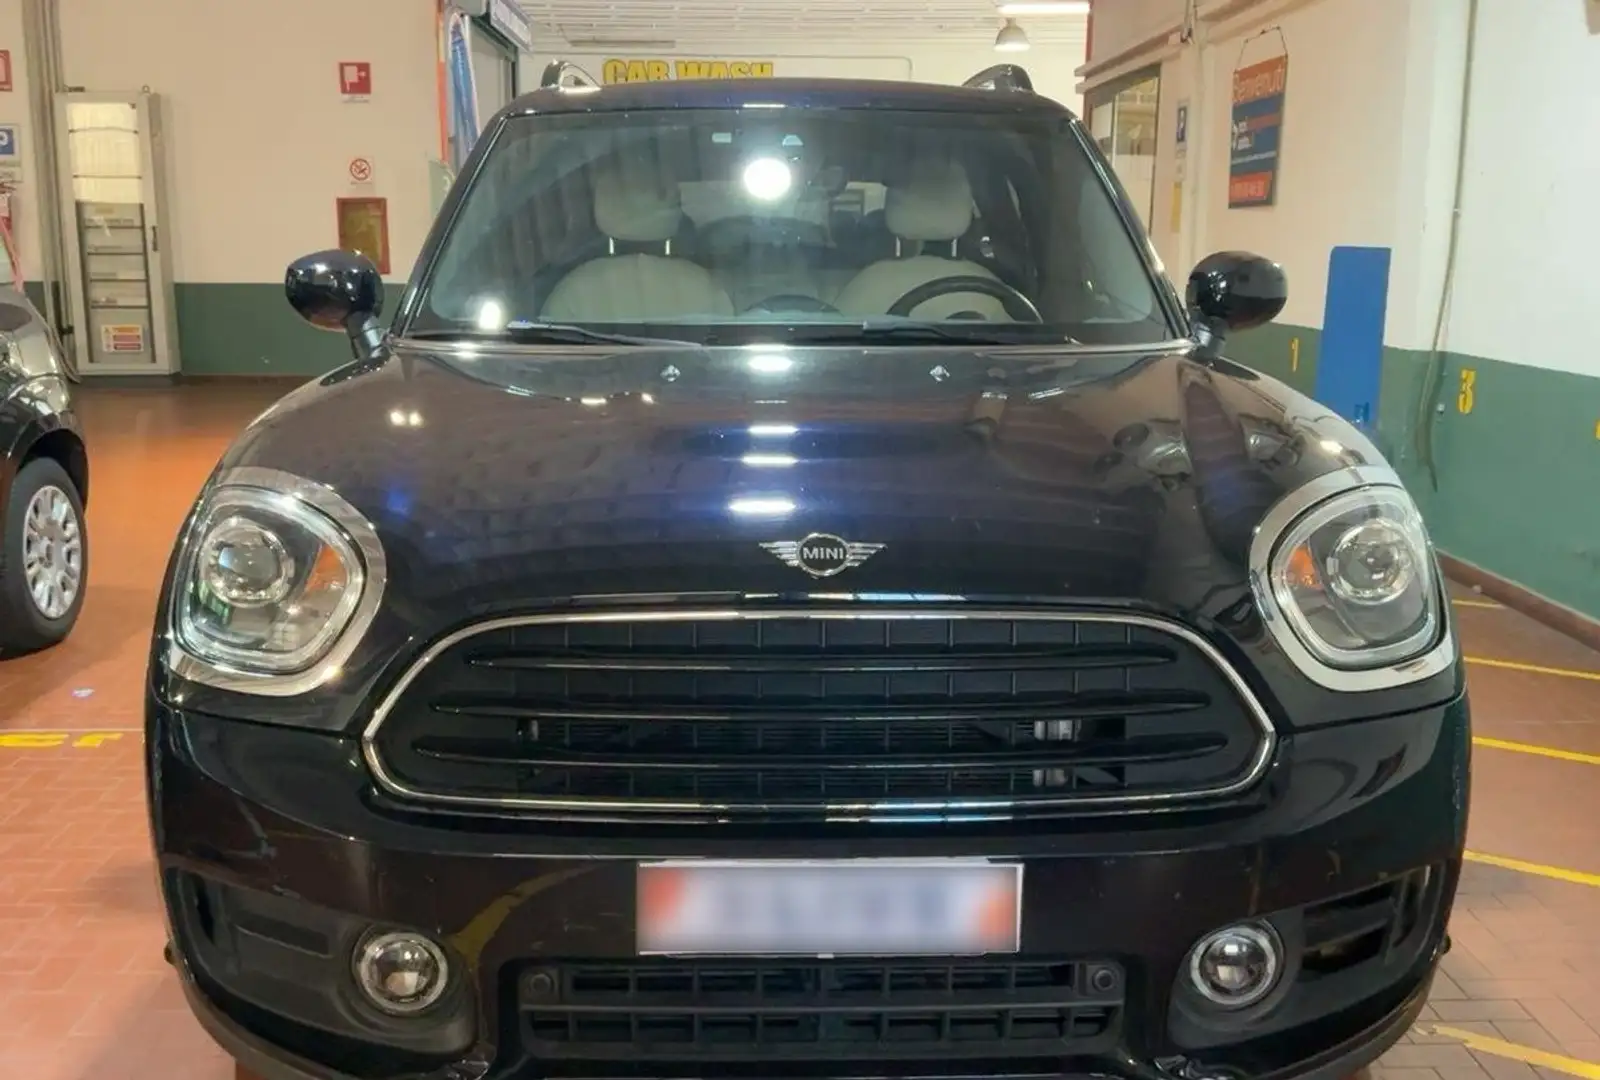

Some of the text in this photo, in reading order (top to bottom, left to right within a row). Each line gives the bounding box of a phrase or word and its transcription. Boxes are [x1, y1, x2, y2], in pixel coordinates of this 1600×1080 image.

[603, 59, 773, 84] CAR WASH
[1290, 337, 1298, 372] 1
[1458, 368, 1475, 414] 3
[803, 547, 844, 560] MINI
